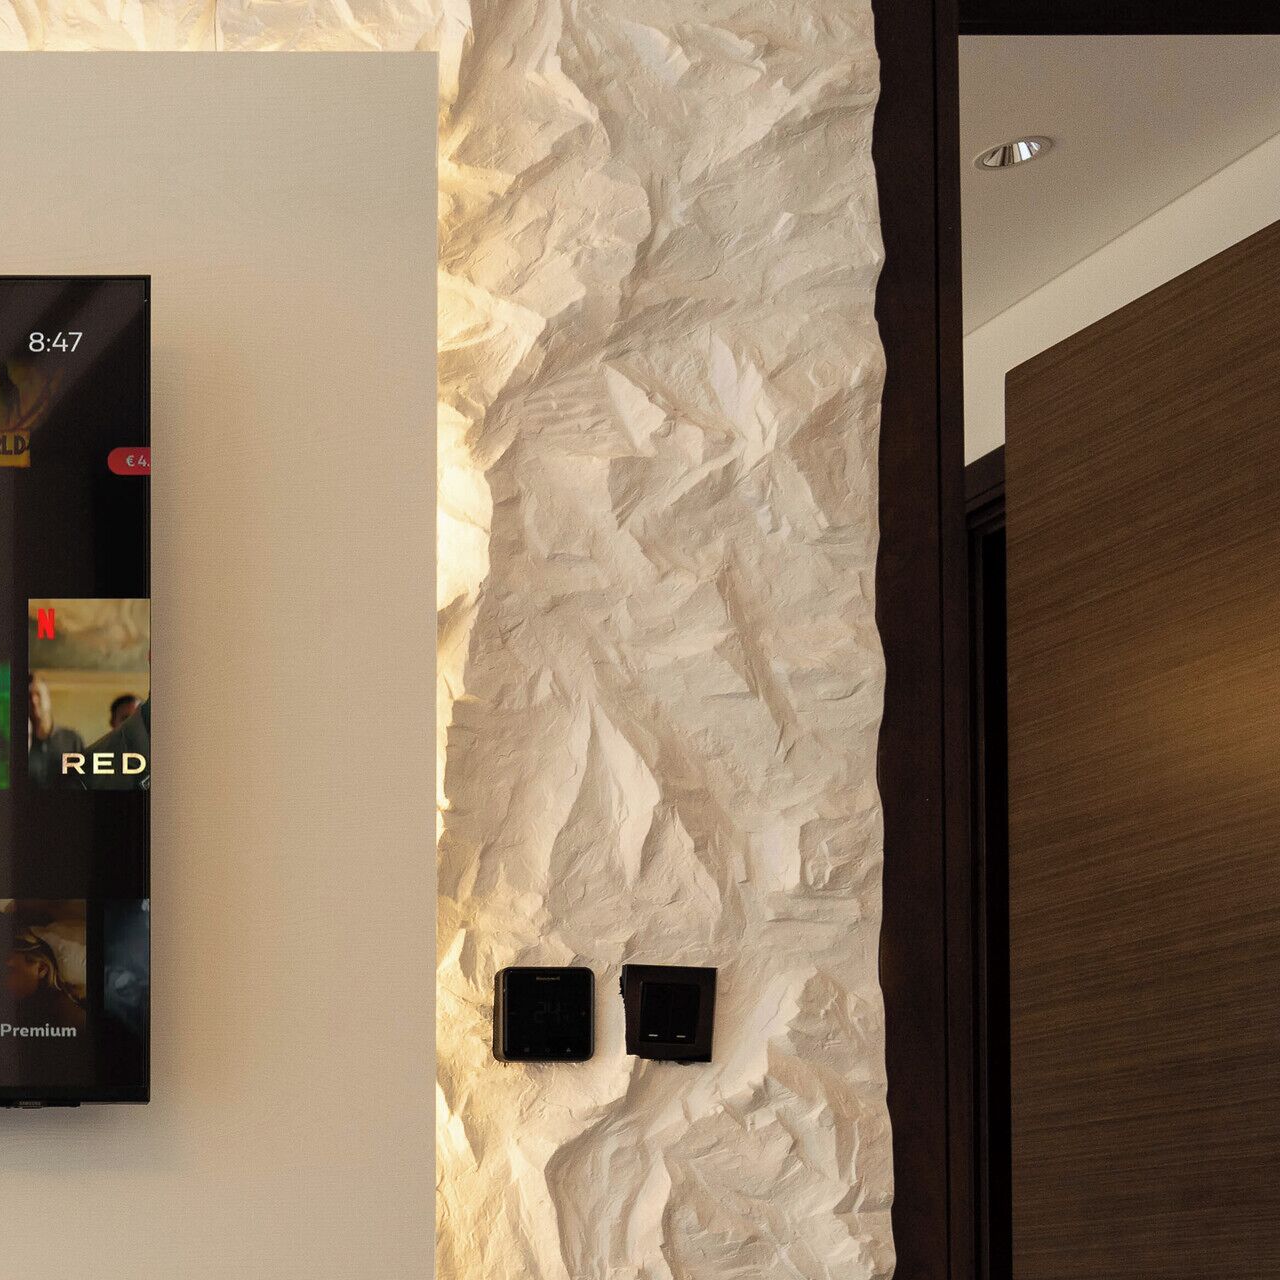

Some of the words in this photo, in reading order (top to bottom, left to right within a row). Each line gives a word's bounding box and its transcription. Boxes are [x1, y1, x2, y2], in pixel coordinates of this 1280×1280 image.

[28, 331, 82, 352] 8:47
[61, 752, 147, 775] RED
[0, 1022, 77, 1038] Premium
